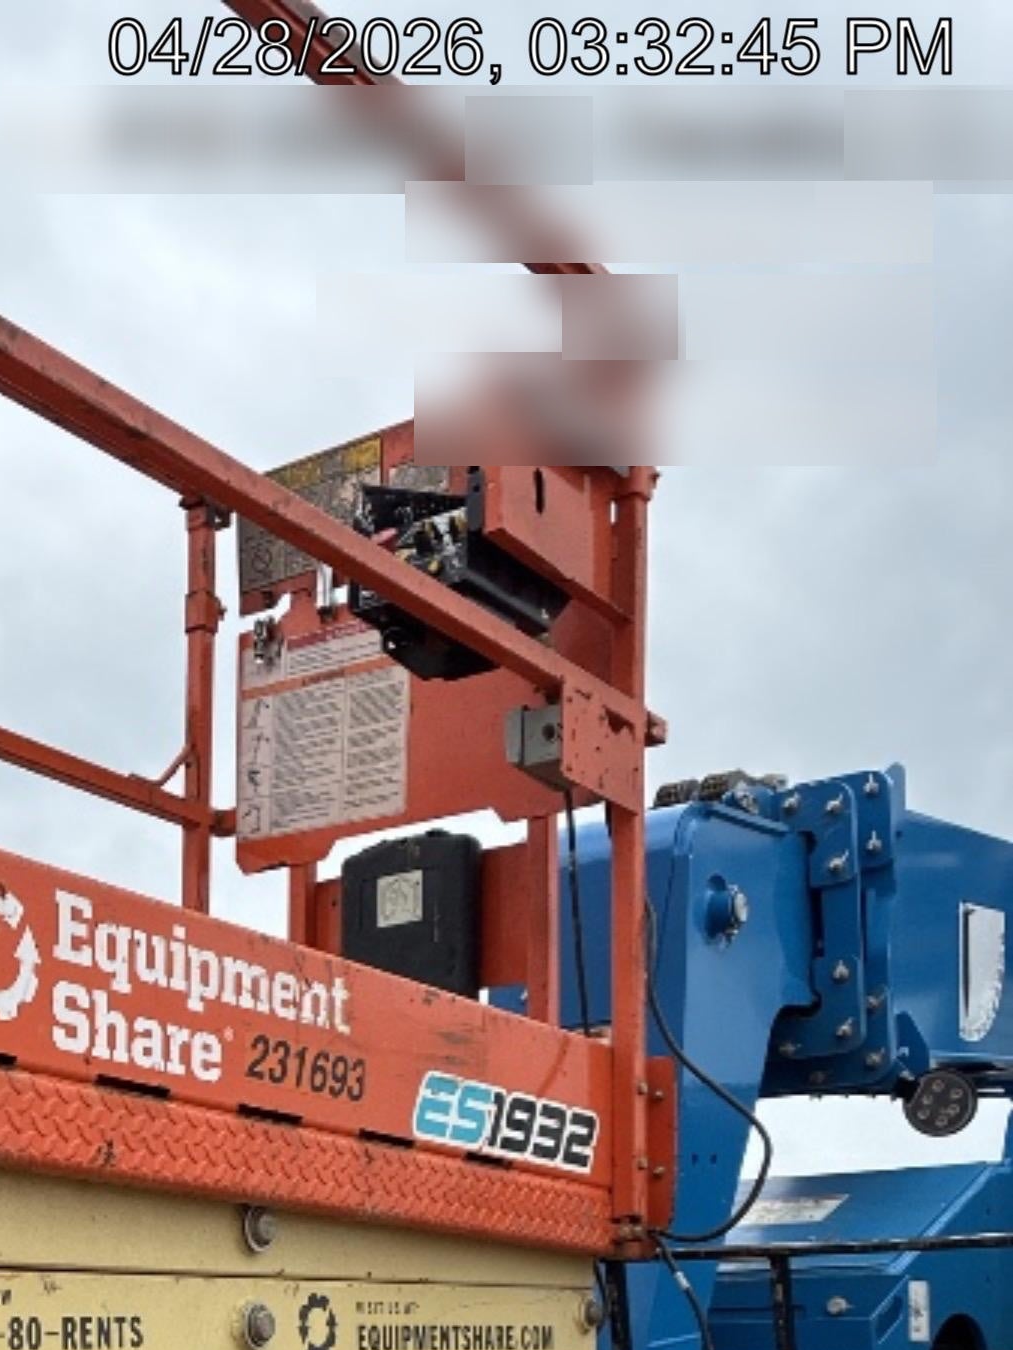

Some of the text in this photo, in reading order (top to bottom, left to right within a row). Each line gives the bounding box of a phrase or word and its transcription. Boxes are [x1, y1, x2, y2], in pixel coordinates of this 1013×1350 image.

[54, 890, 350, 1033] Equipment
[52, 982, 223, 1082] Share
[244, 1034, 366, 1102] 231693
[414, 1070, 599, 1174] ES1932
